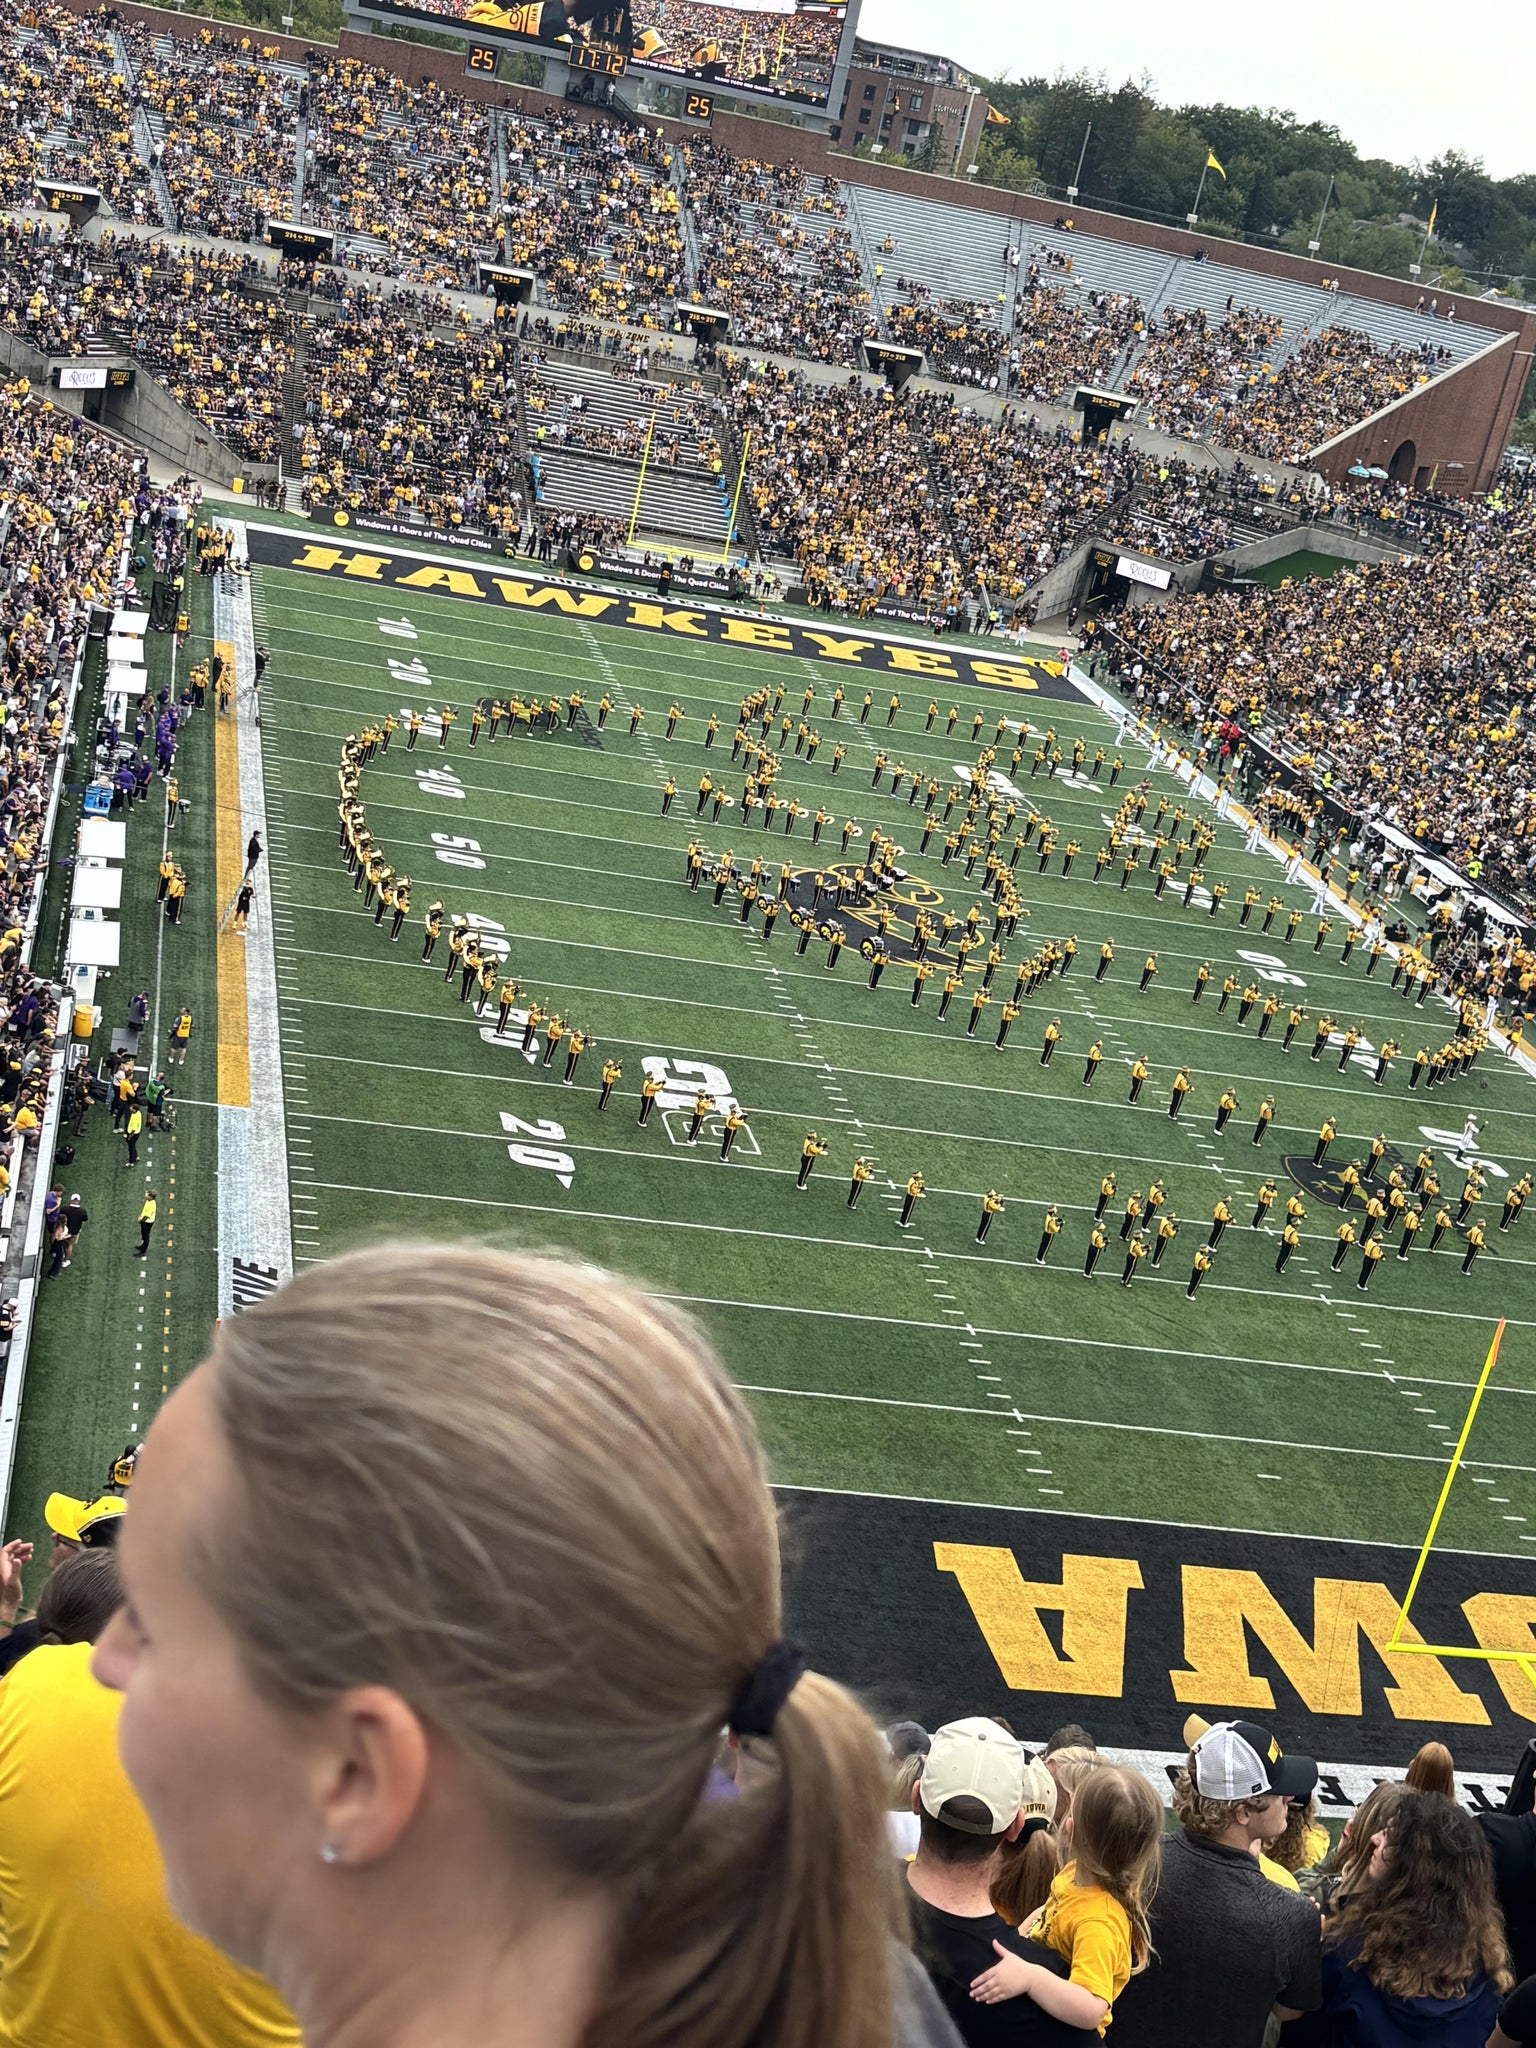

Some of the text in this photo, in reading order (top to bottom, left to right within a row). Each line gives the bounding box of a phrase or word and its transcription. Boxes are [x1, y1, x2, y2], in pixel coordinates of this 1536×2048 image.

[471, 48, 494, 70] 25
[578, 49, 624, 74] 17:12
[687, 95, 710, 117] 25
[934, 104, 962, 116] COURTYARD
[625, 331, 651, 344] ZONE
[355, 517, 492, 550] Windows & Doors of The Quad Cities
[599, 561, 633, 575] Windows
[634, 567, 641, 576] &
[673, 574, 687, 585] The
[687, 577, 708, 590] Quad
[708, 580, 730, 592] Cities
[291, 545, 1040, 689] HAWKEYES
[888, 607, 896, 616] of
[897, 609, 911, 619] The
[387, 658, 433, 686] 20
[414, 768, 466, 799] 40
[430, 832, 487, 870] 50
[1235, 949, 1308, 988] 50
[498, 1111, 576, 1174] 20
[1025, 1802, 1047, 1814] IOWA
